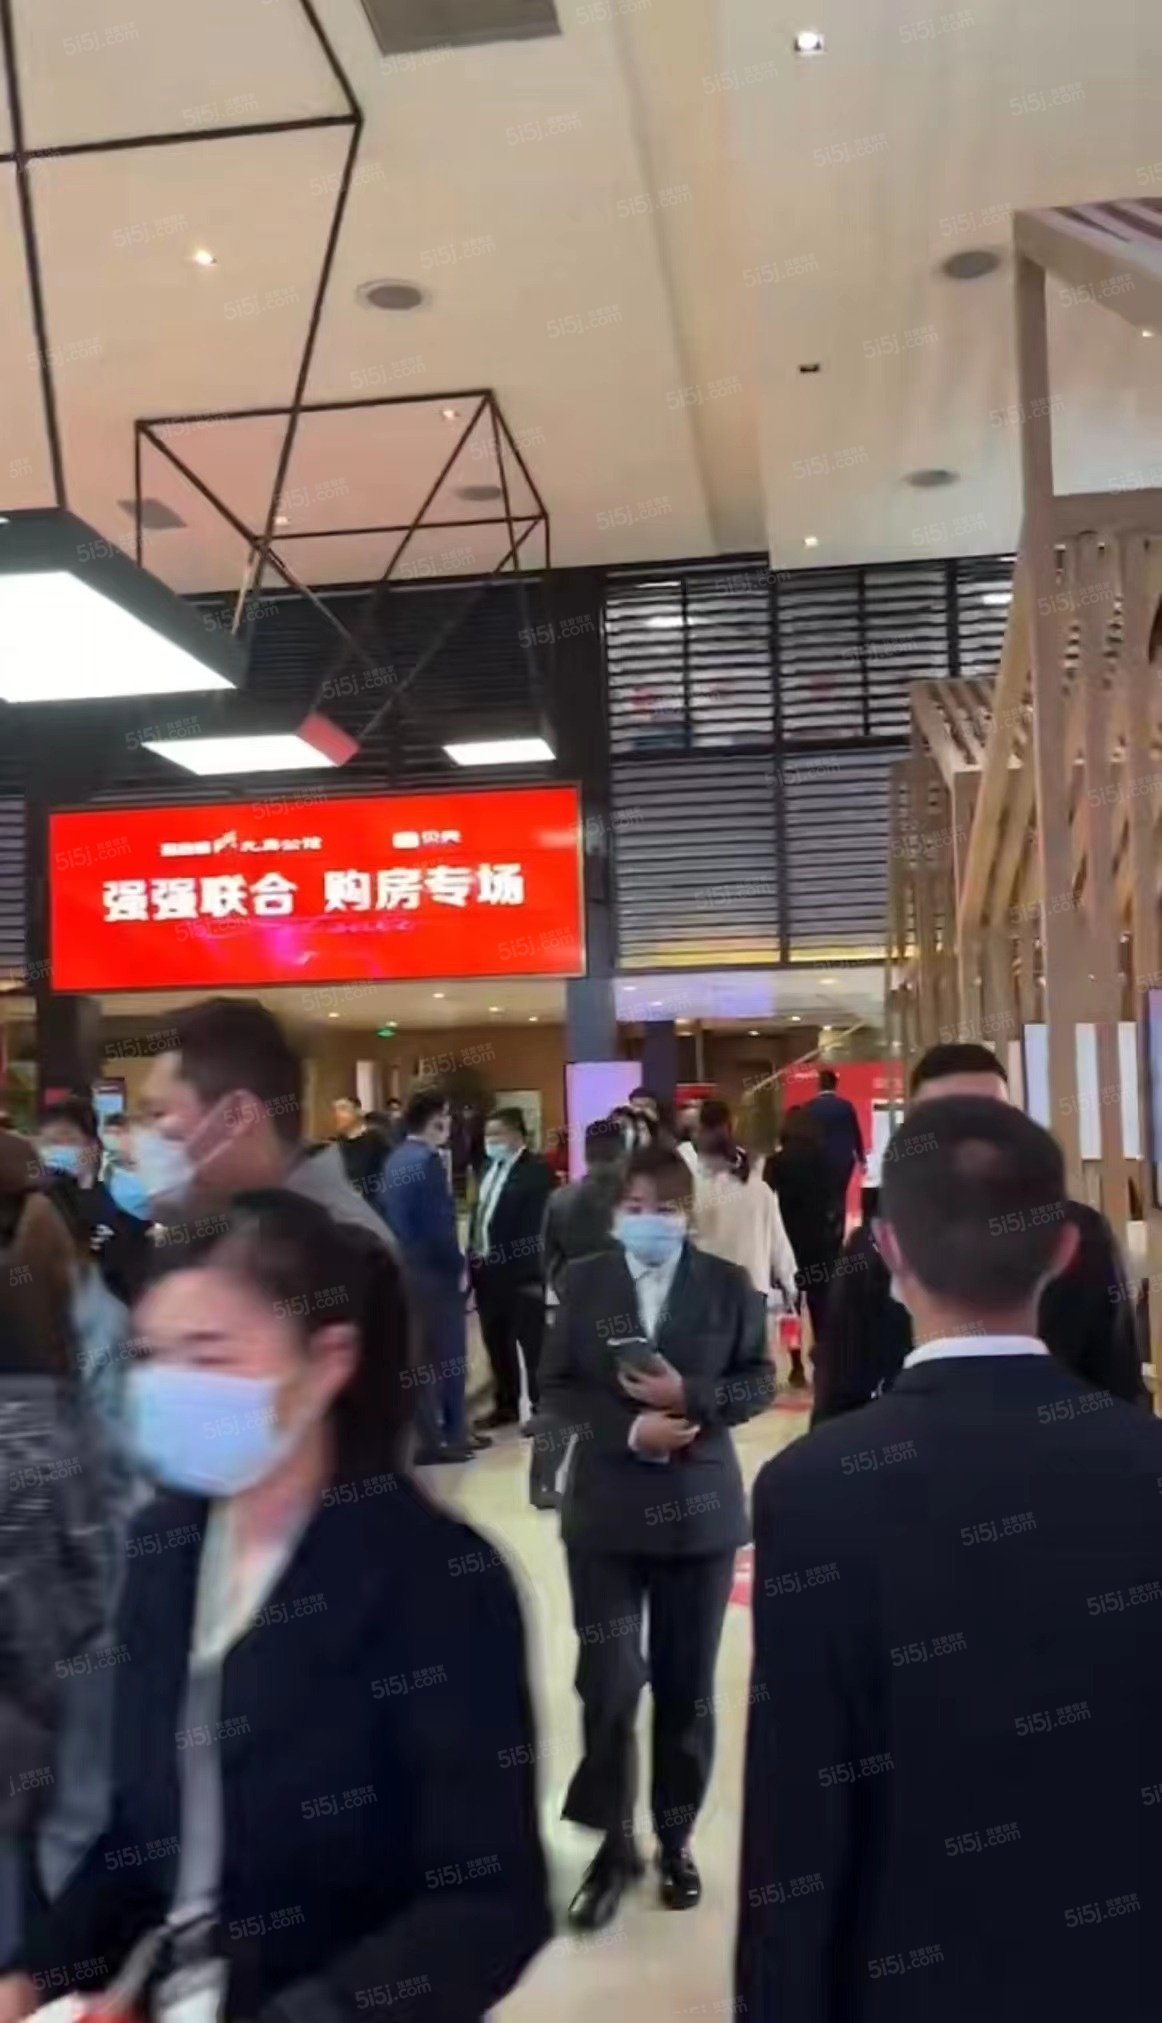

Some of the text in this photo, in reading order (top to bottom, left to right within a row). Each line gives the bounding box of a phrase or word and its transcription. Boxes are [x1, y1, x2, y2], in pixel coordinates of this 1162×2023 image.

[102, 871, 298, 922] 强强联合
[324, 862, 525, 912] 购房专场
